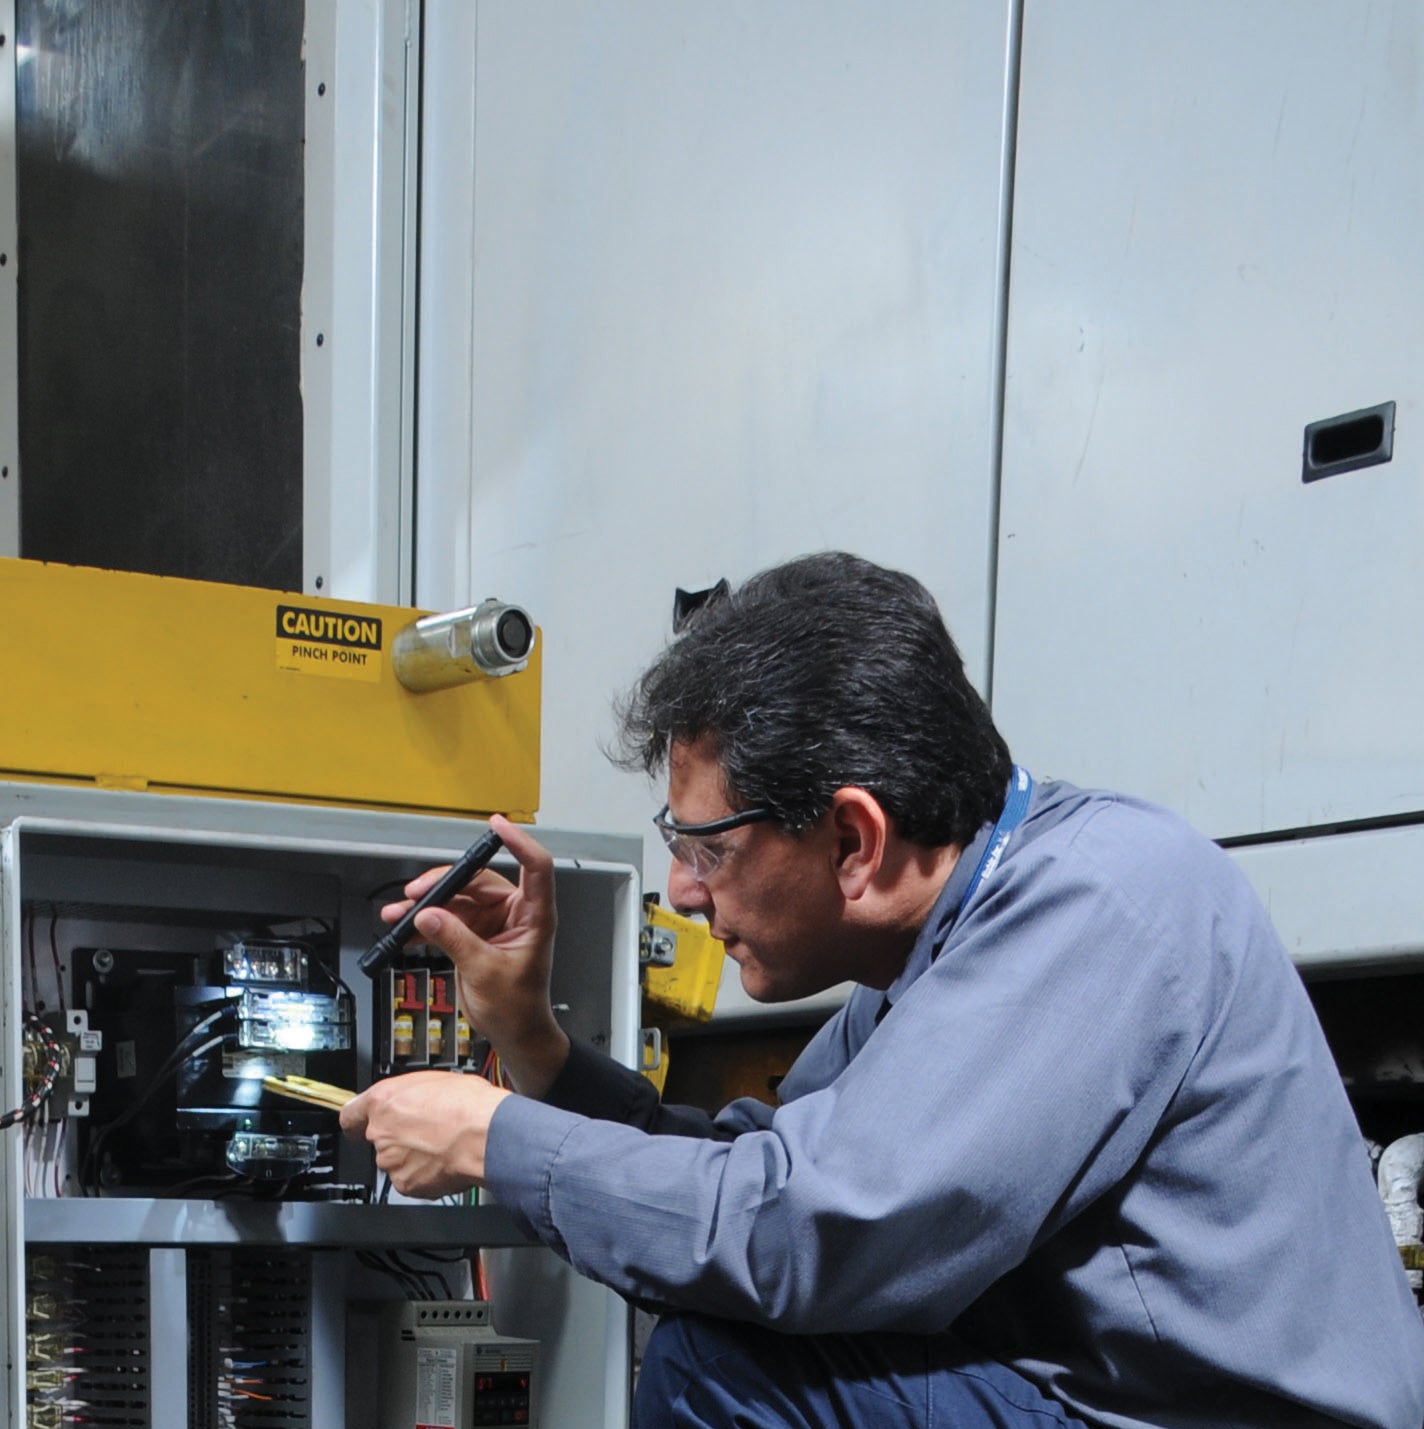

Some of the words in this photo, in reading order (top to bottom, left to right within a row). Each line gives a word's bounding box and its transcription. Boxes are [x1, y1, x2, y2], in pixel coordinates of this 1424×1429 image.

[282, 611, 377, 645] CAUTION
[292, 645, 328, 661] PINCH
[332, 650, 368, 666] POINT
